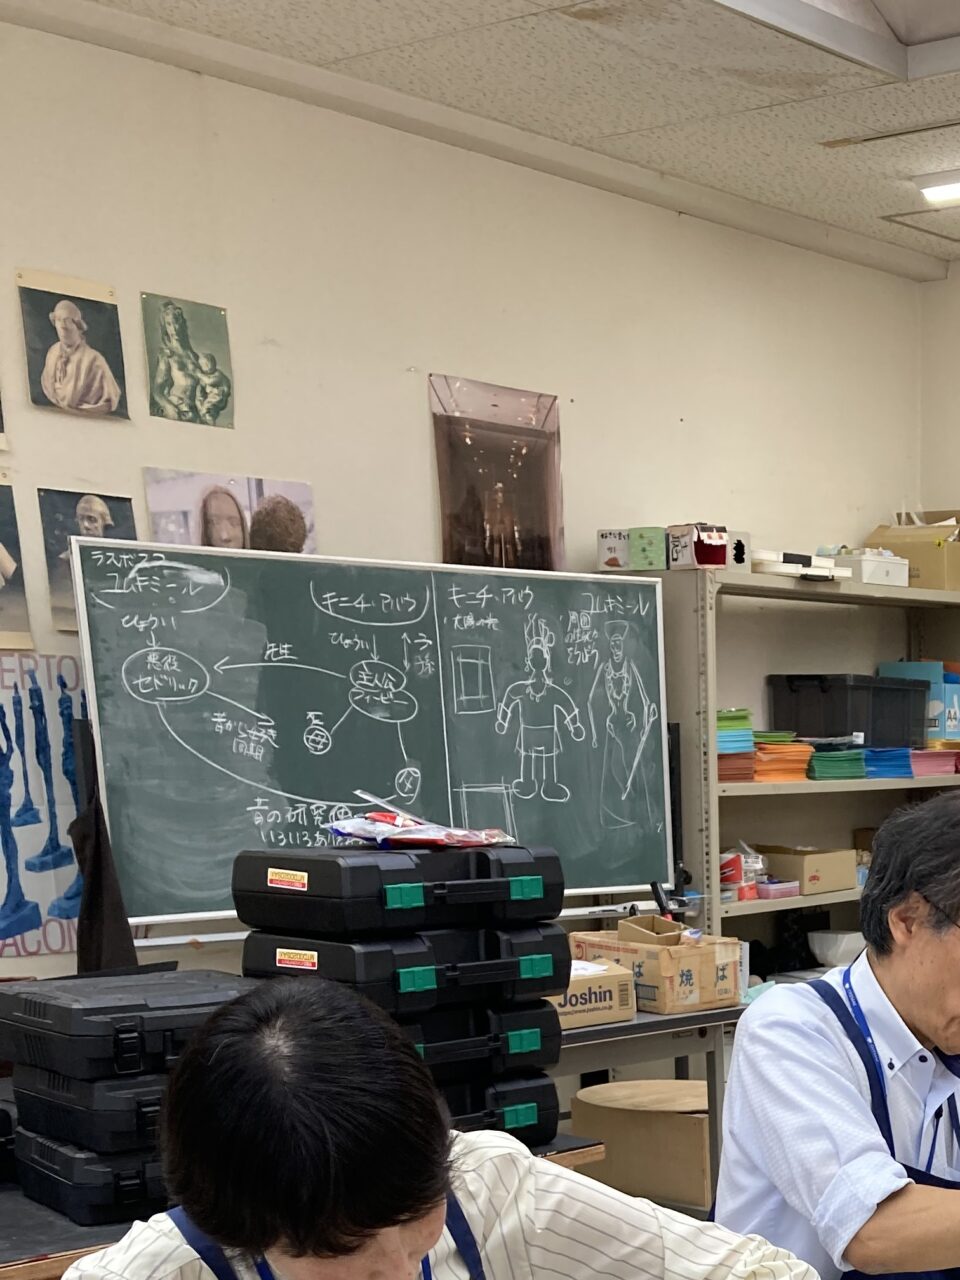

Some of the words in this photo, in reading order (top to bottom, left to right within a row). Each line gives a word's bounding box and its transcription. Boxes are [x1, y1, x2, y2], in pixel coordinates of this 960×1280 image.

[263, 643, 300, 661] 先生
[132, 675, 199, 694] セドリック
[356, 661, 398, 692] 主人公
[558, 984, 613, 1008] Joshin
